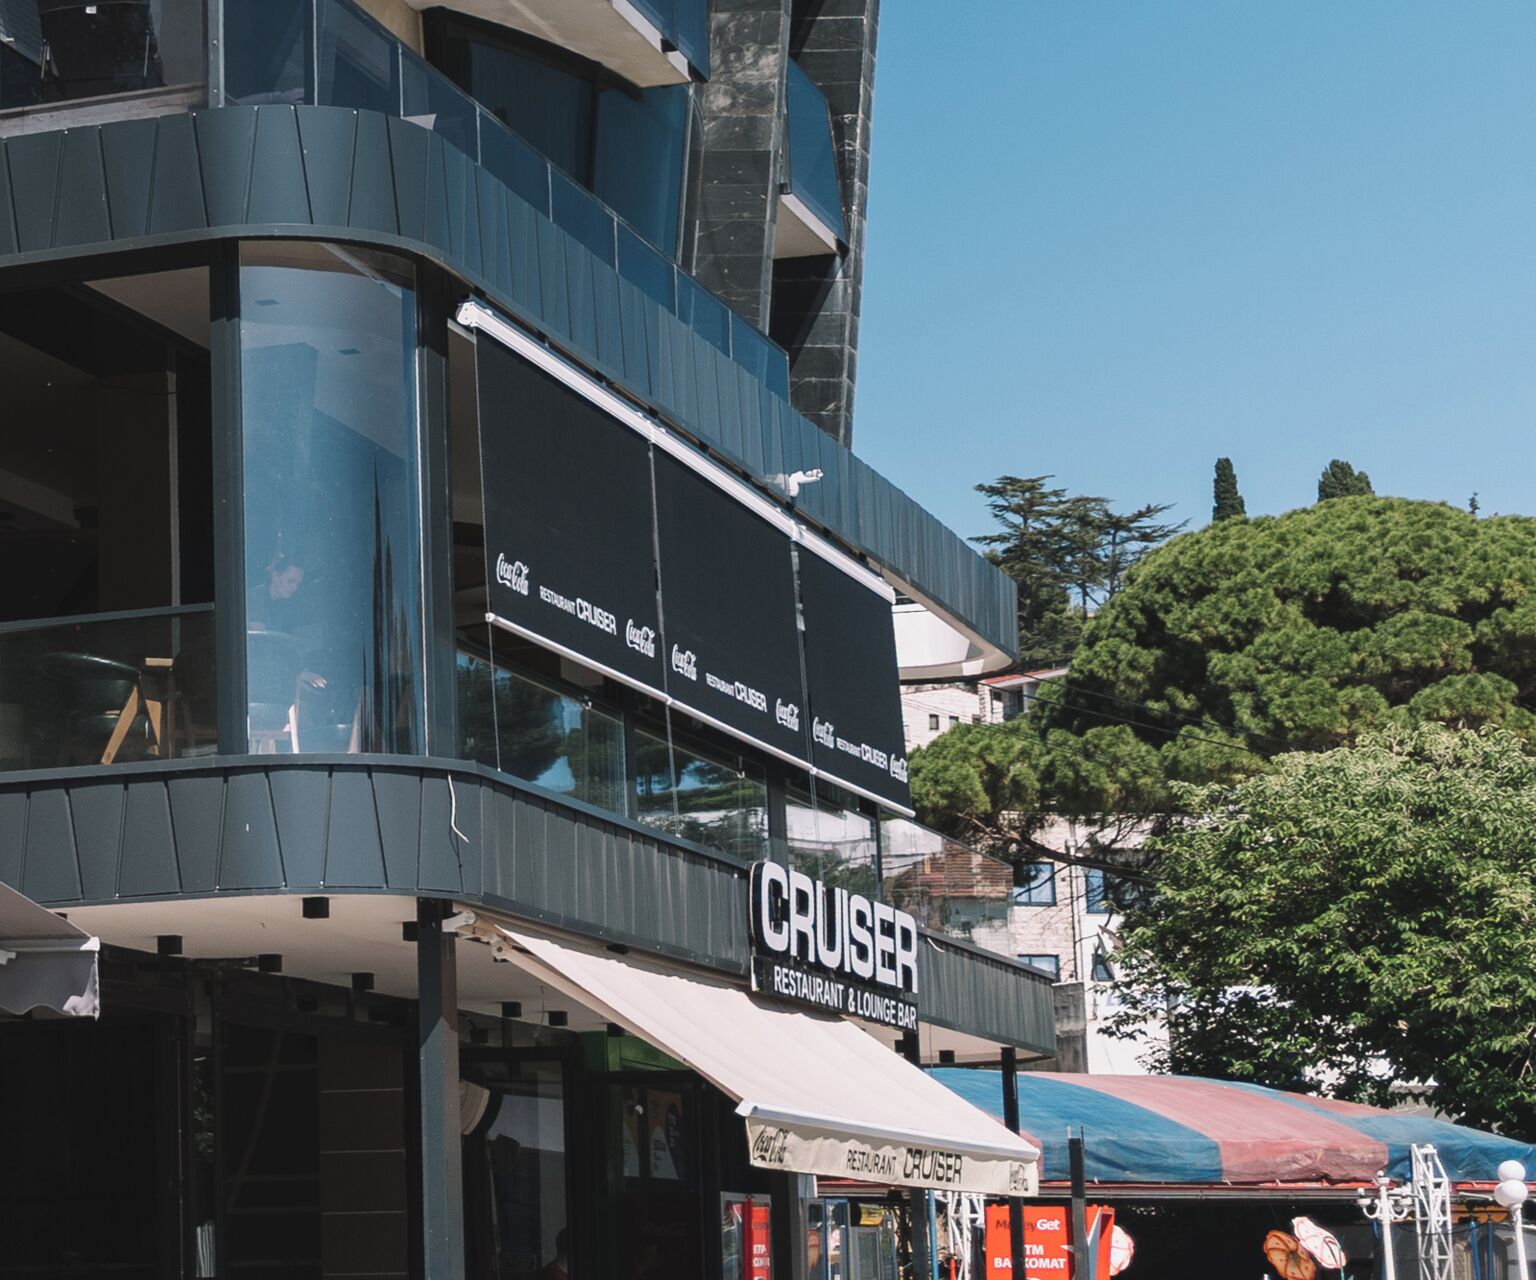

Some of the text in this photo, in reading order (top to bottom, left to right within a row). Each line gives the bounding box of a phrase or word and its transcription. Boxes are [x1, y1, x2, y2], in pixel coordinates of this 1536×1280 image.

[539, 585, 576, 615] RESTAURANT
[576, 597, 617, 636] CRUISER
[734, 681, 768, 713] CRUISER
[861, 743, 888, 771] CRUISER
[761, 861, 918, 994] CRUISER
[773, 965, 917, 1030] RESTAURANT & LOUNGE BAR
[847, 1148, 897, 1176] RESTAURANT
[903, 1147, 963, 1184] CRUISER
[993, 1257, 1066, 1269] BAKOMAT
